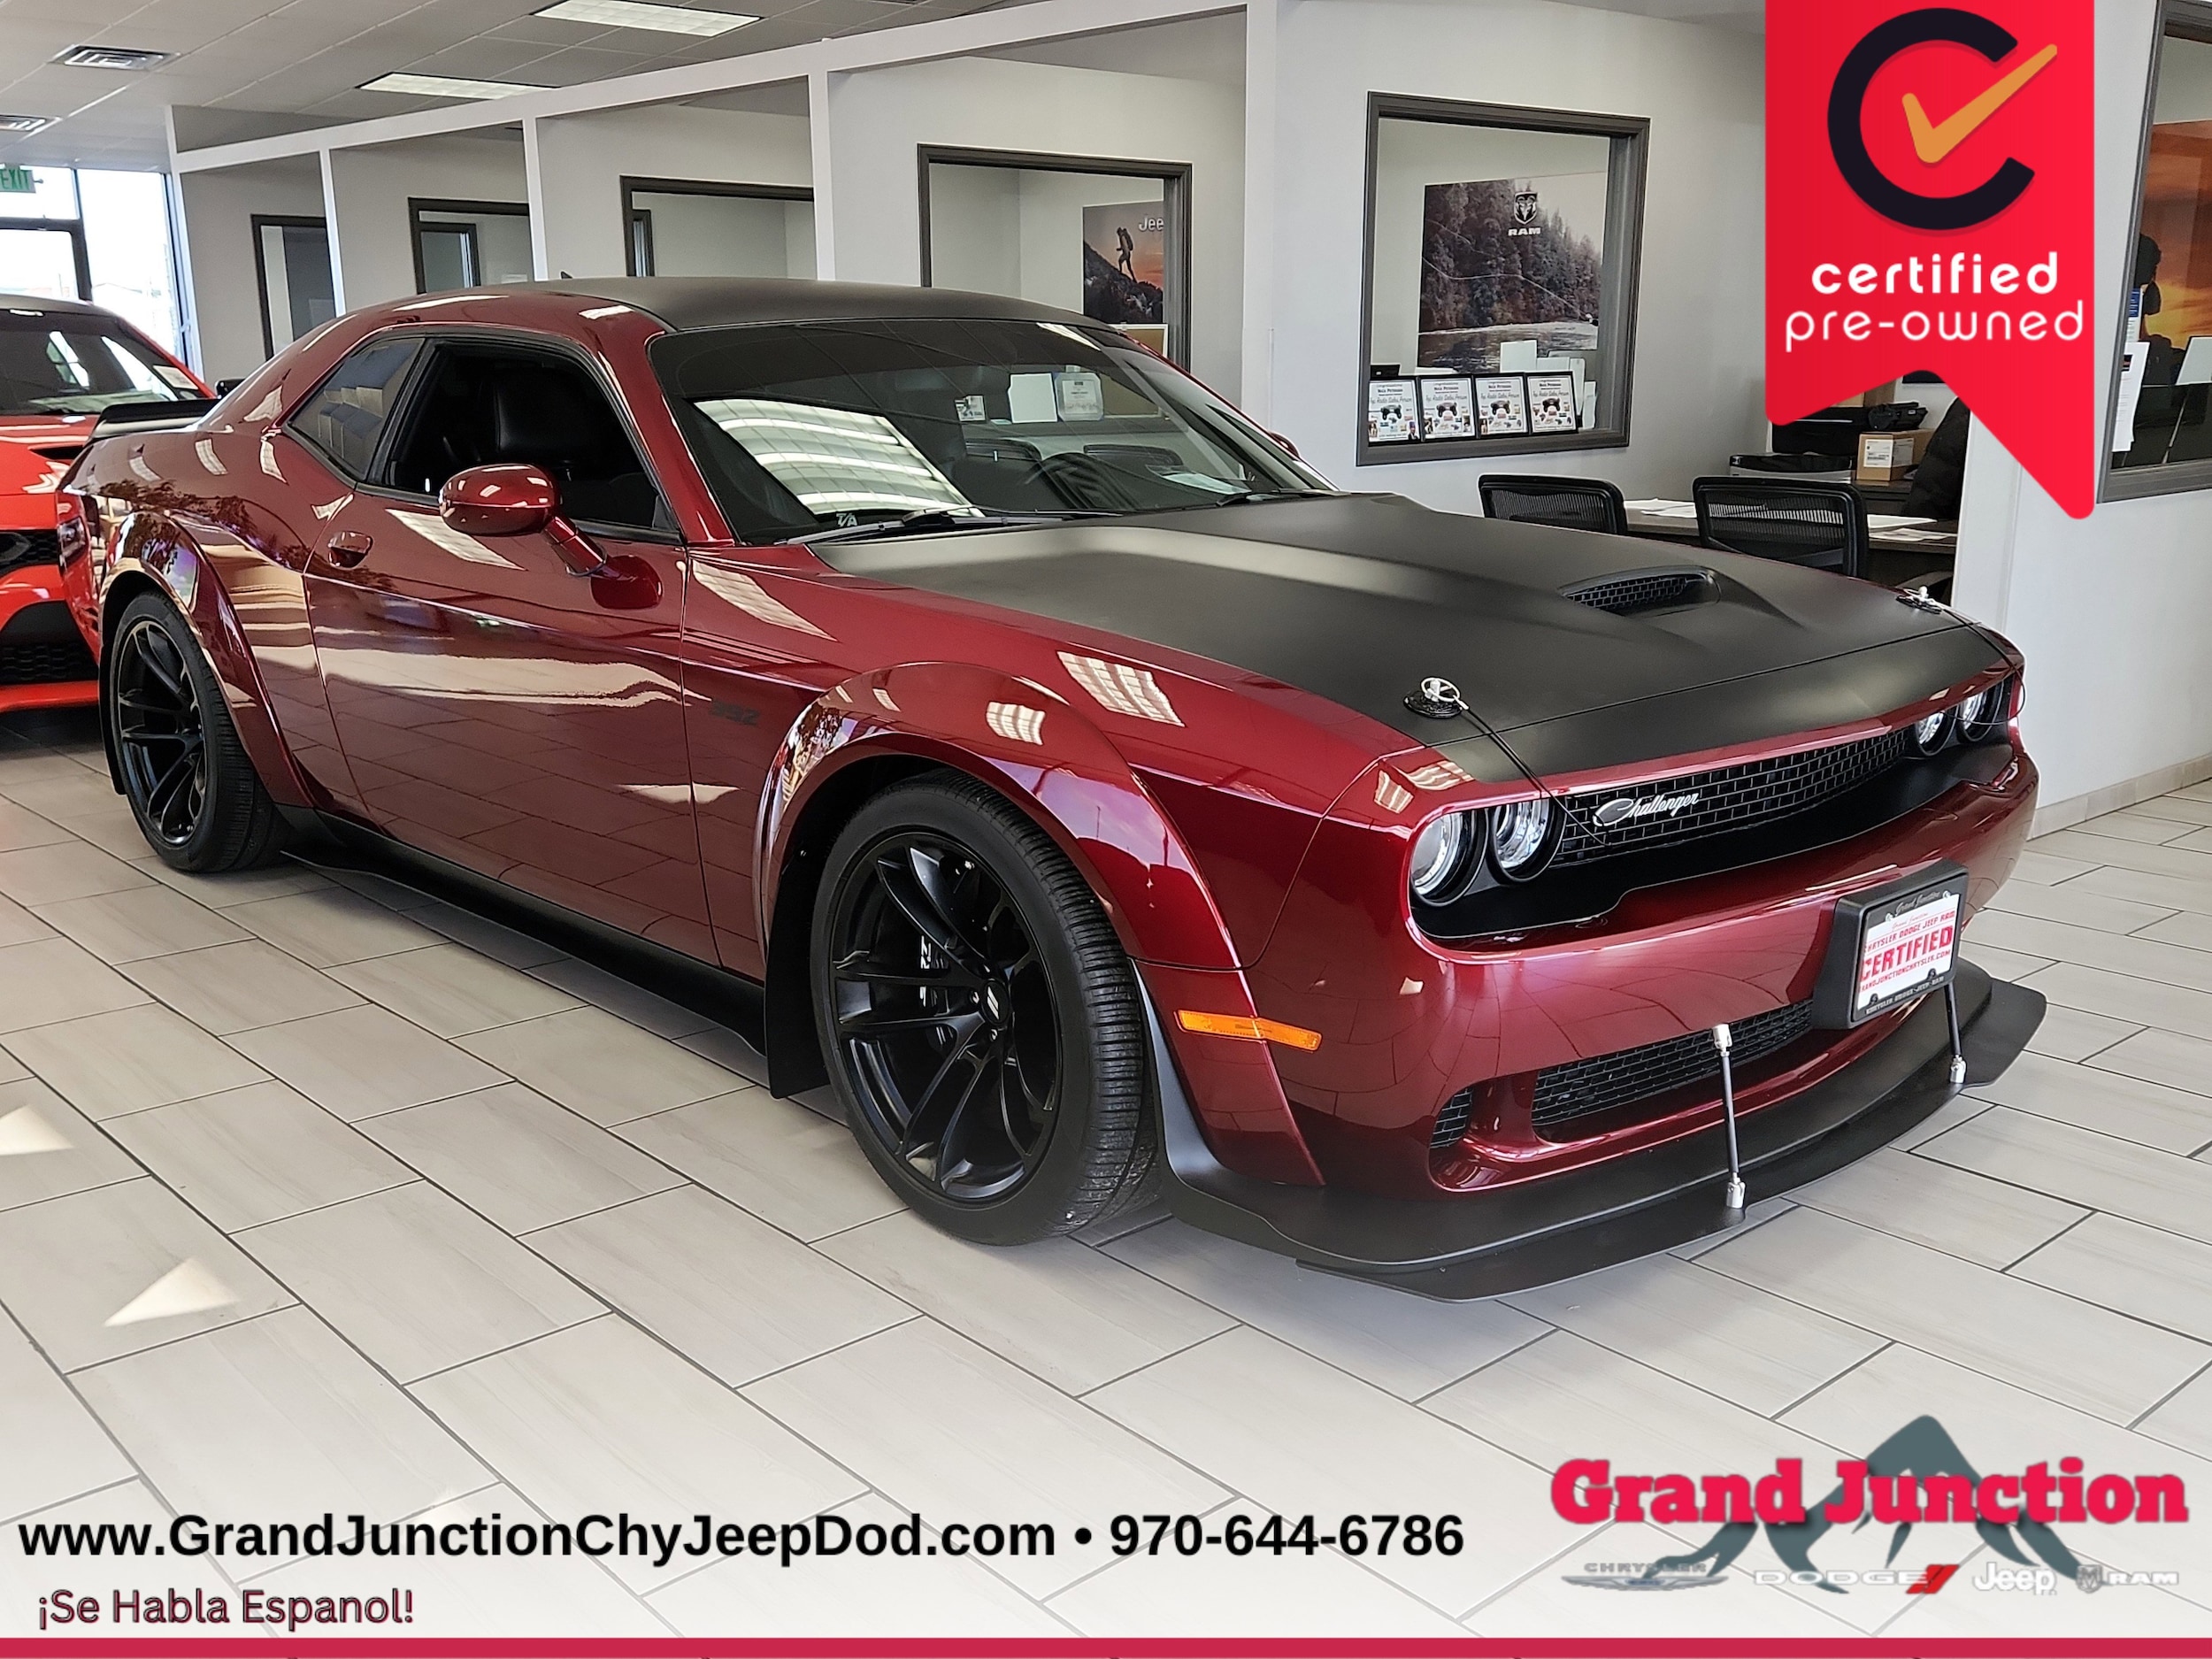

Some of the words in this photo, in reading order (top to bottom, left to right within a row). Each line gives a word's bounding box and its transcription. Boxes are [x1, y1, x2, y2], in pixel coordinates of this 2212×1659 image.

[0, 169, 30, 189] EXIT
[1139, 216, 1164, 231] Jee
[835, 512, 858, 527] T/A
[1592, 793, 1700, 827] Challenger
[1899, 923, 1921, 938] DODGE
[1922, 917, 1939, 929] JEEP
[1860, 925, 1954, 982] CERTIFIED
[1861, 949, 1951, 991] RANDJUNCTIONCHRYSLER.COM
